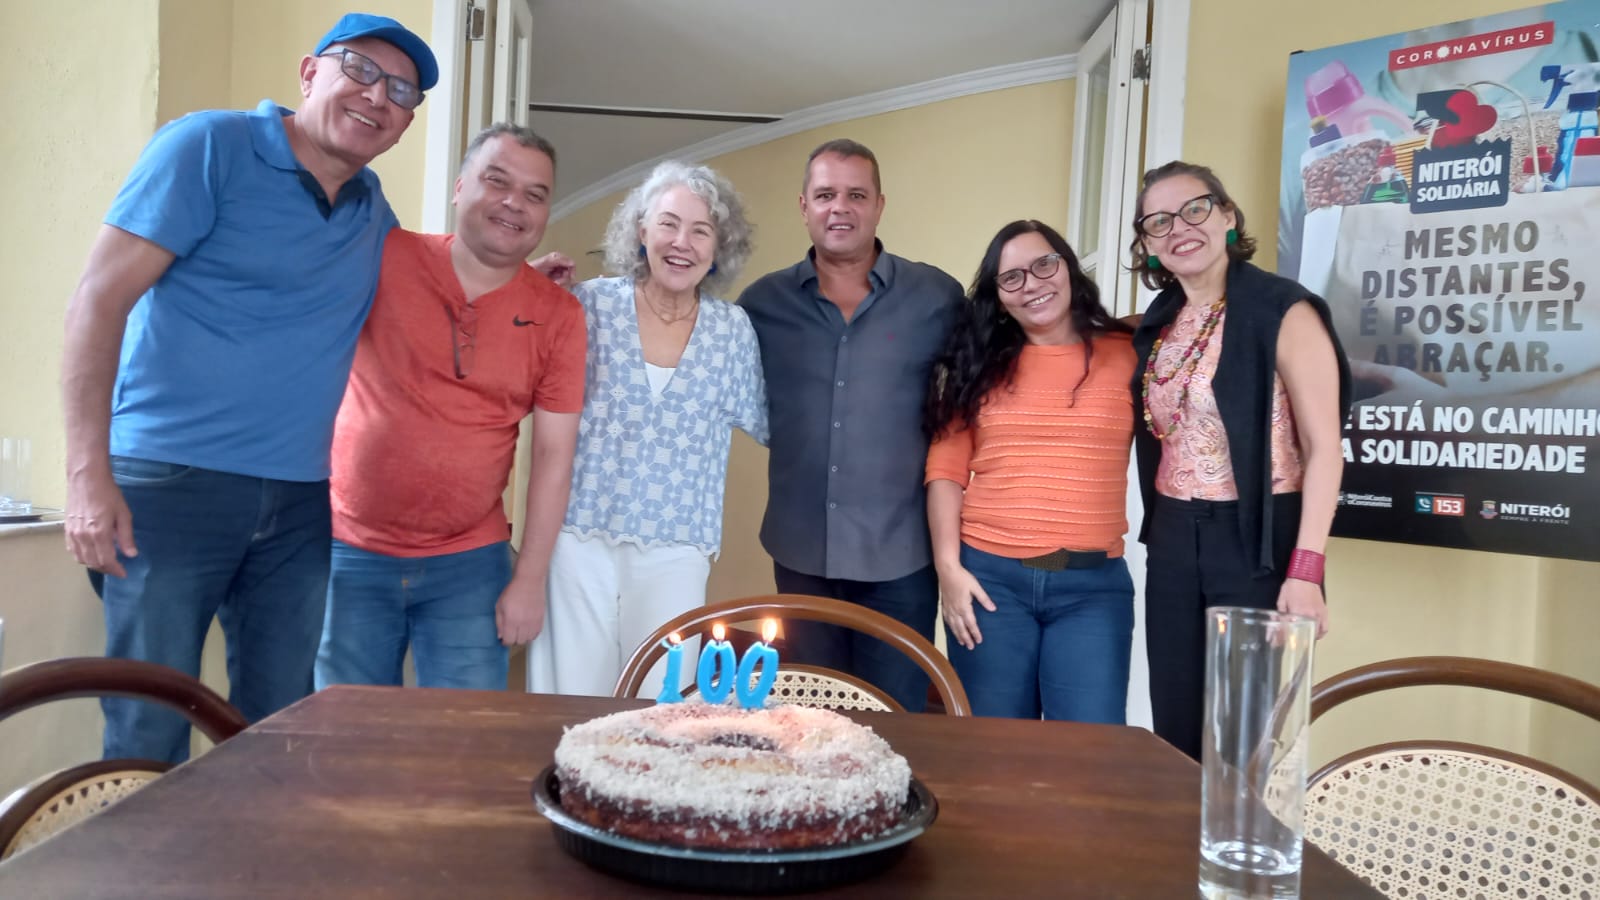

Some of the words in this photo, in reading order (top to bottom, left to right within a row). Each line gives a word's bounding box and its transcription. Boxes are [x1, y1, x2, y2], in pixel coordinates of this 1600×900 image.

[1418, 151, 1502, 183] NITERÓI
[1416, 179, 1501, 203] SOLIDÁRIA
[1404, 220, 1539, 260] MESMO
[1361, 258, 1586, 302] DISTANTES,
[1360, 300, 1378, 336] É
[1395, 294, 1583, 335] POSSÍVEL
[1373, 341, 1564, 382] ABRAÇAR.
[1359, 400, 1426, 431] ESTÁ
[1433, 406, 1474, 432] NO
[1481, 407, 1600, 437] CAMINH
[1361, 438, 1587, 474] SOLIDARIEDADE
[1435, 500, 1461, 514] 153
[1500, 503, 1570, 518] NITERÓI
[656, 639, 779, 711] 100
